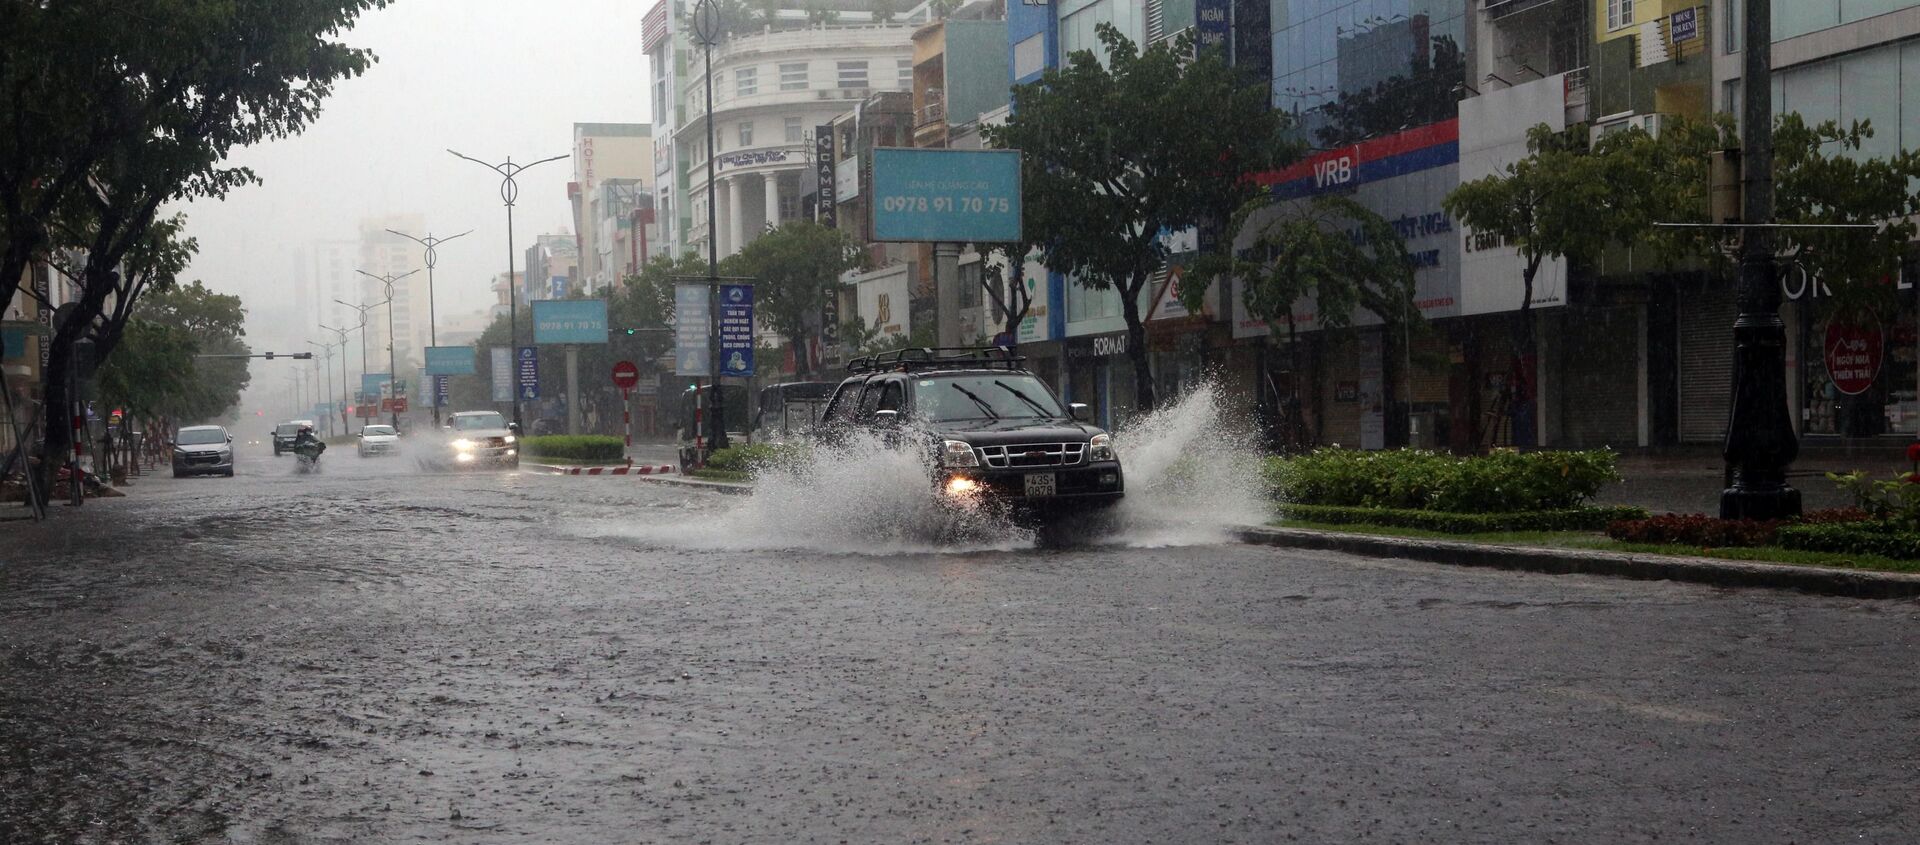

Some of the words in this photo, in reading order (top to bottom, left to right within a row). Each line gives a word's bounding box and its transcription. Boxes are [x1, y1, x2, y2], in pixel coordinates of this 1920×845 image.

[1201, 8, 1224, 21] NGÂN
[584, 137, 593, 188] HOTEL
[1313, 156, 1351, 189] VRB
[820, 153, 832, 220] CAMERA
[884, 196, 928, 213] 0978
[933, 197, 953, 213] 91
[961, 197, 982, 213] 70
[988, 197, 1009, 213] 75
[564, 321, 574, 330] 91
[592, 320, 601, 330] 75
[1093, 335, 1125, 357] FORMAT
[1031, 474, 1049, 486] 43S
[1029, 486, 1052, 497] 0878
